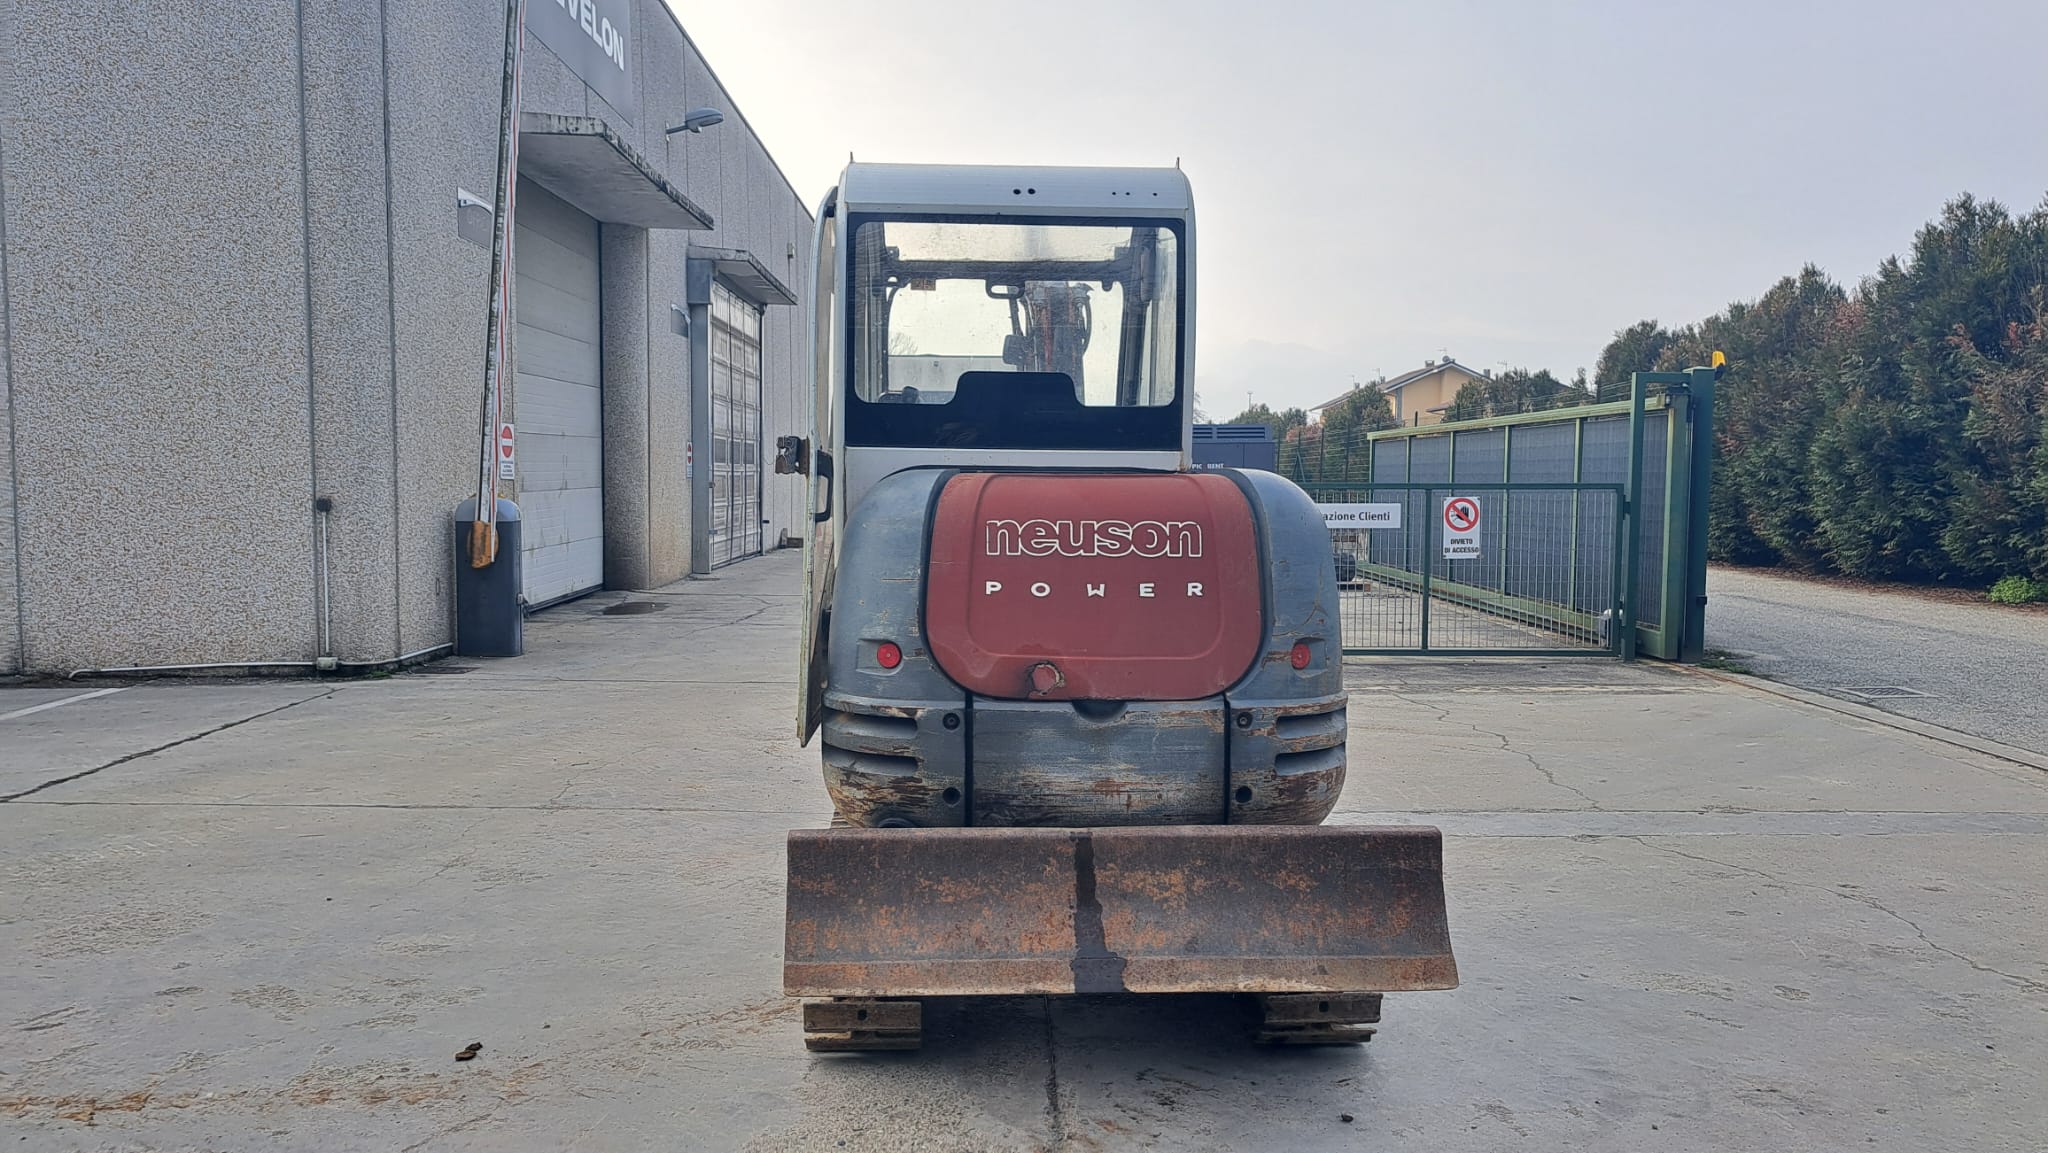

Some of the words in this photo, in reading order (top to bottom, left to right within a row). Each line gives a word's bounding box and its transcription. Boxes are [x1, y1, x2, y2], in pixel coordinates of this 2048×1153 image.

[556, 0, 624, 72] VELON
[1358, 511, 1391, 521] Clienti
[986, 519, 1202, 557] neuson
[985, 580, 1203, 598] POWER
